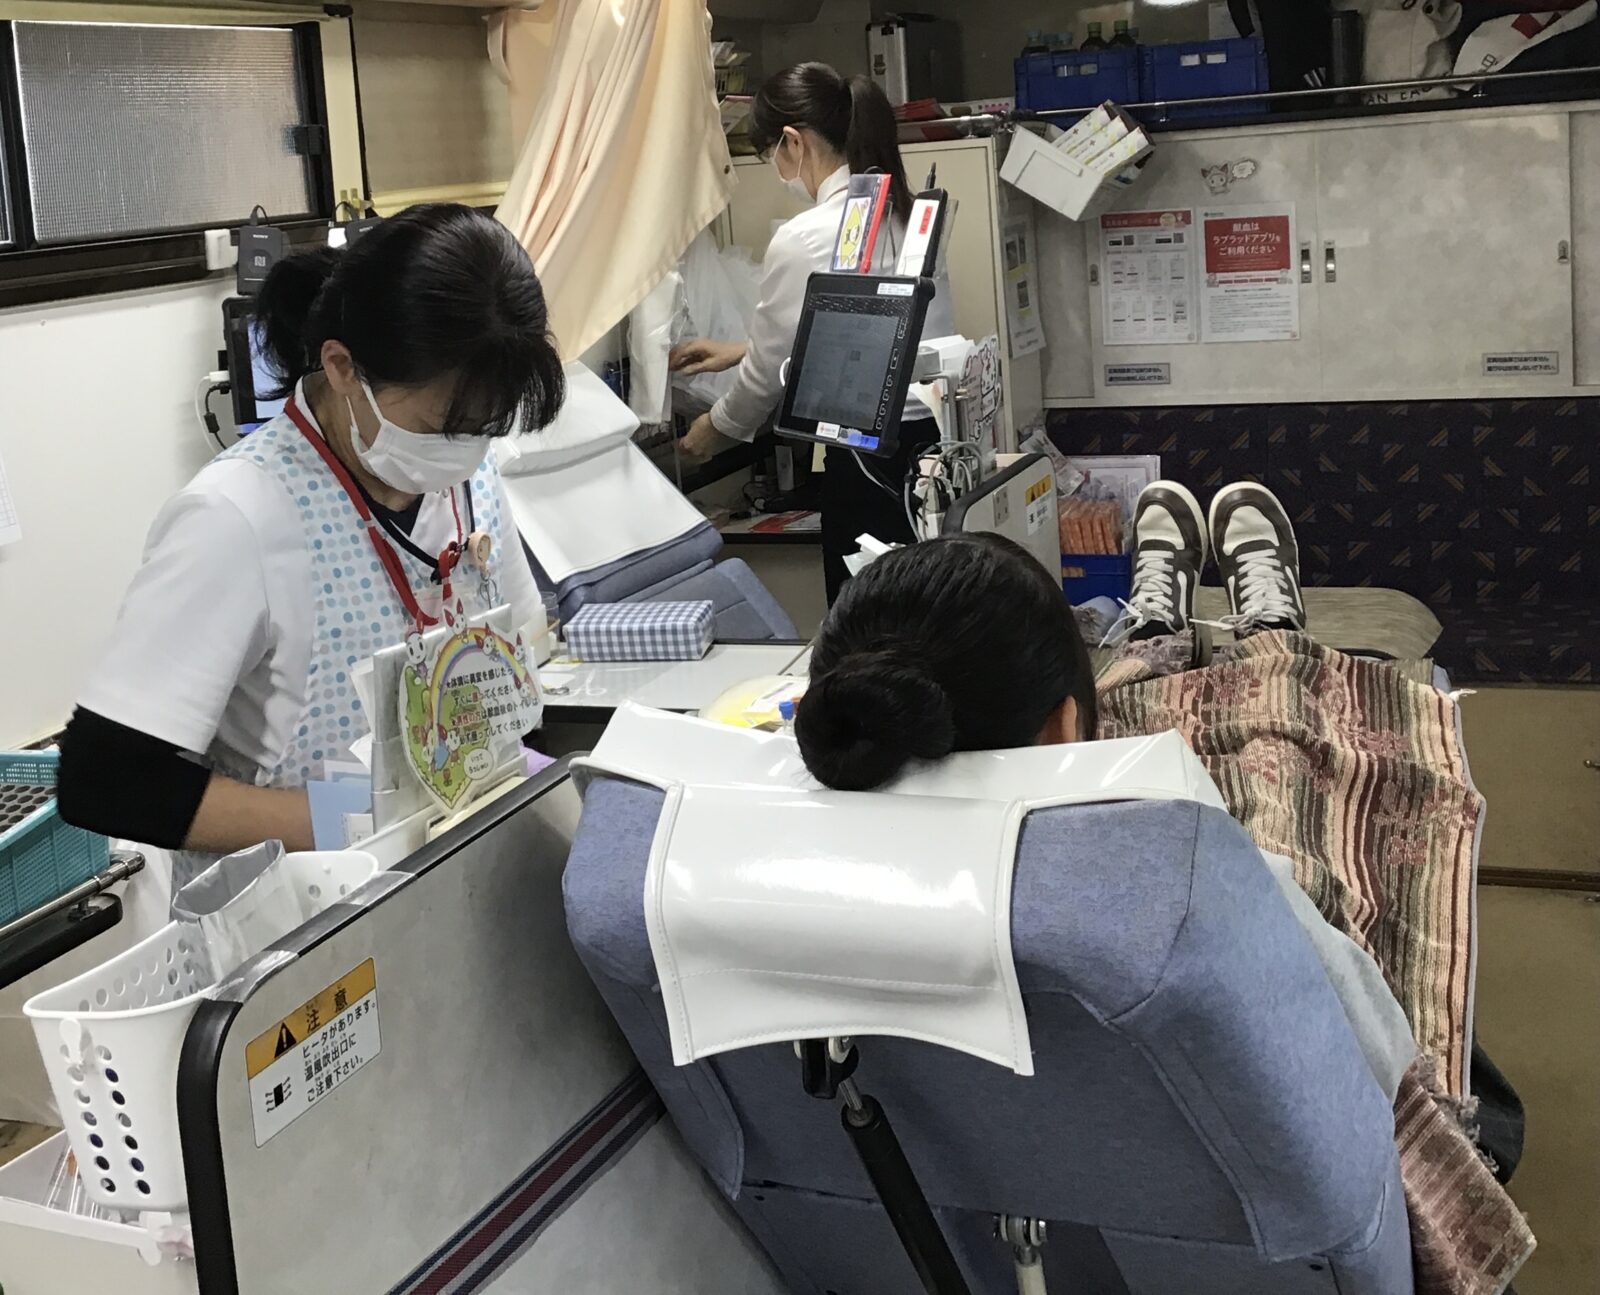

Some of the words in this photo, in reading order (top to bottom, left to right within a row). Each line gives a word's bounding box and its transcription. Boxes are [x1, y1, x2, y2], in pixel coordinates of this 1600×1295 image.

[302, 999, 376, 1059] ヒータがあります。
[305, 987, 348, 1033] 注意
[304, 1032, 357, 1082] 温風吹出口に
[306, 1054, 363, 1103] ご注意下さい。
